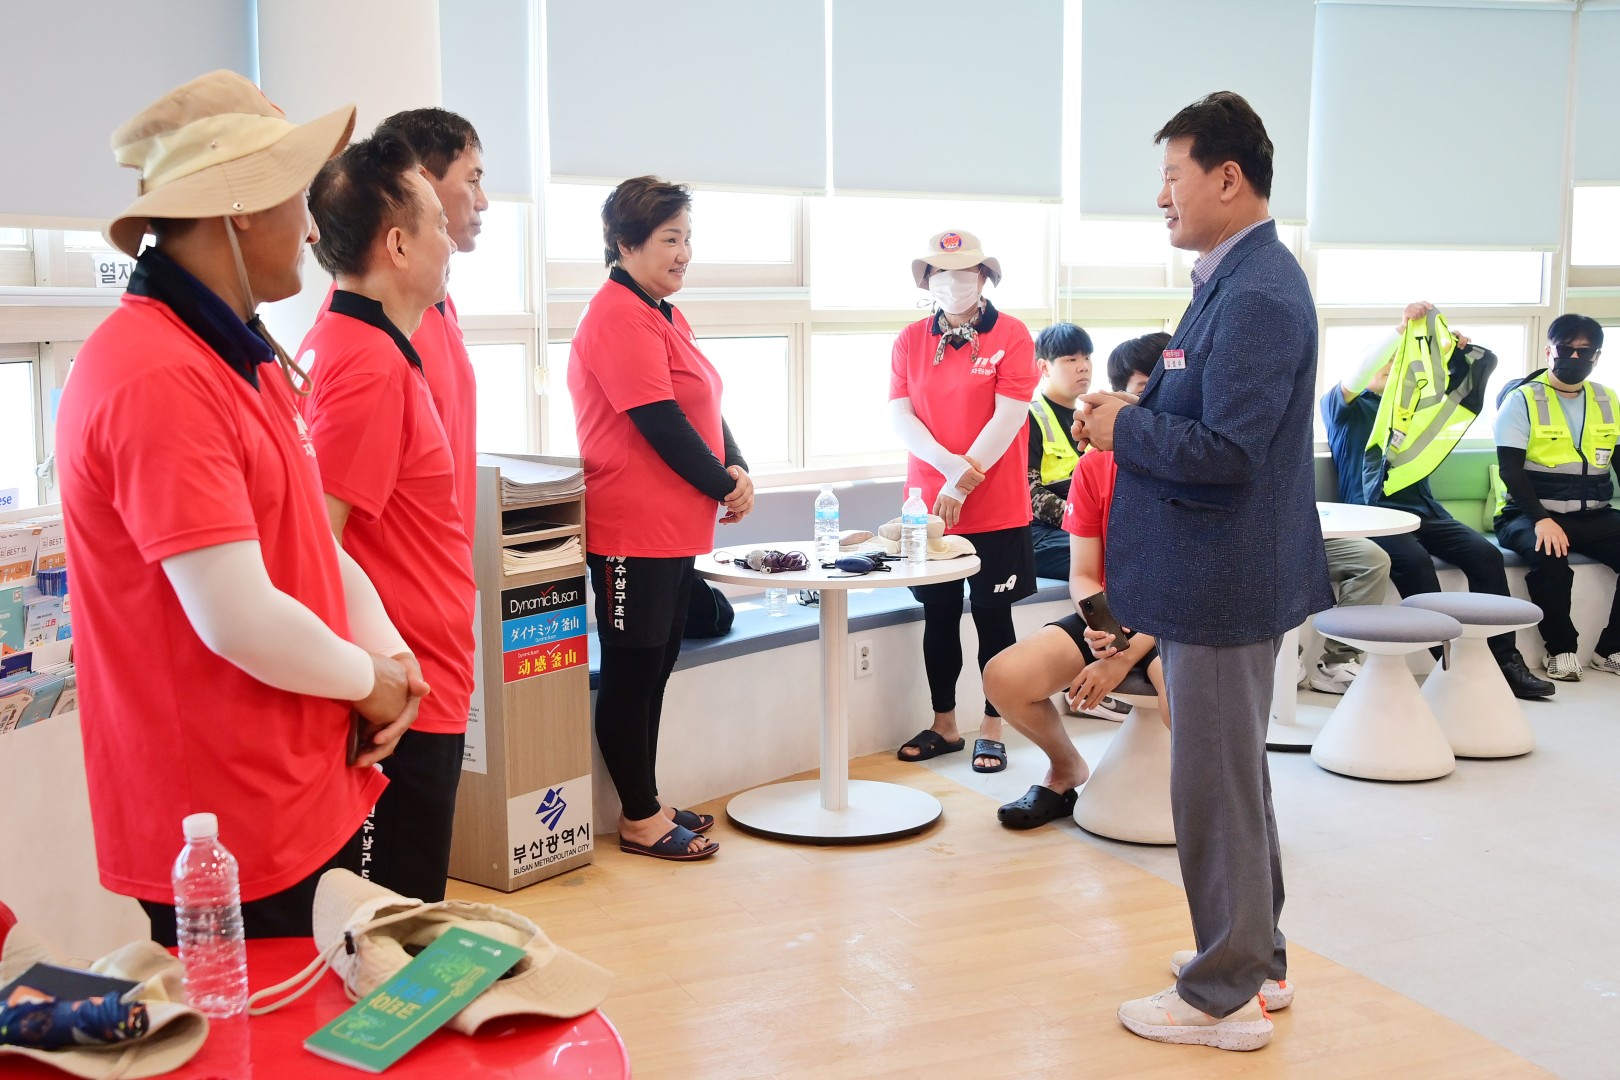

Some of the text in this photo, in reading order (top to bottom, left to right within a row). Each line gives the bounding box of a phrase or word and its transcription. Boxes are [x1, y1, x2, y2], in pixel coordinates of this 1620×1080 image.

[7, 548, 20, 557] BEST
[510, 590, 578, 615] Dynamic Busan
[614, 564, 627, 631] 수상구조대
[511, 616, 579, 643] ダイナミック 釜山
[513, 822, 590, 865] 부산광역시
[513, 843, 590, 876] BUSAN METROPOLITAN CITY
